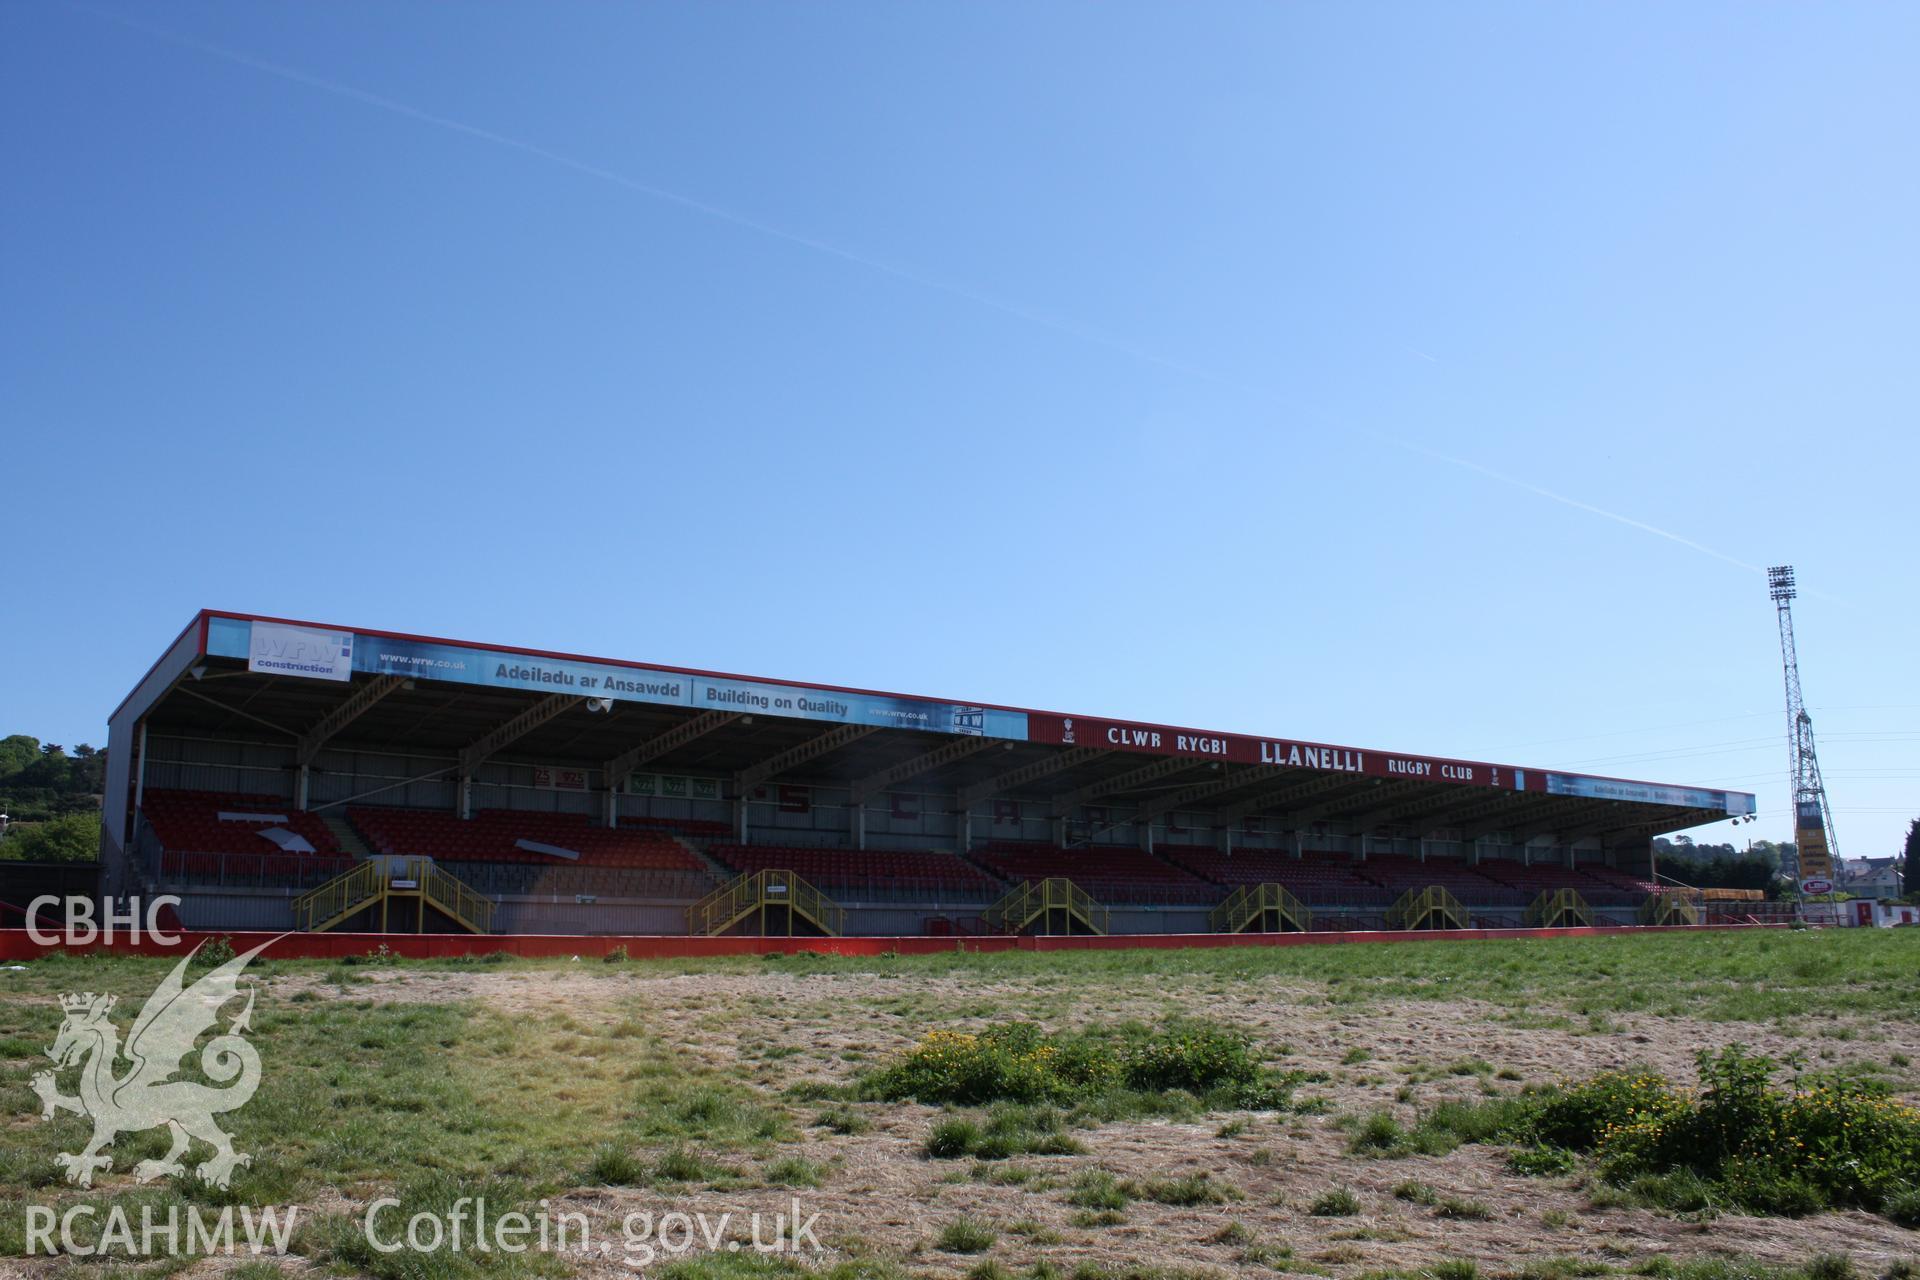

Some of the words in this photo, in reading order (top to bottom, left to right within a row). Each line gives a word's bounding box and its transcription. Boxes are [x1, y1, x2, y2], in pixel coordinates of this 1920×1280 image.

[257, 659, 333, 674] construction
[379, 652, 466, 670] www.wrw.co.uk
[495, 663, 574, 686] Adeiladu
[580, 675, 598, 688] ar
[603, 675, 680, 698] Ansawdd
[706, 687, 769, 709] Building
[775, 697, 793, 710] on
[797, 697, 849, 717] Quality
[1107, 727, 1161, 748] CLWR
[1177, 735, 1227, 755] RYGBI
[1260, 741, 1364, 773] LLANELLI
[1388, 758, 1432, 776] RUGBY
[1441, 764, 1473, 780] CLUB
